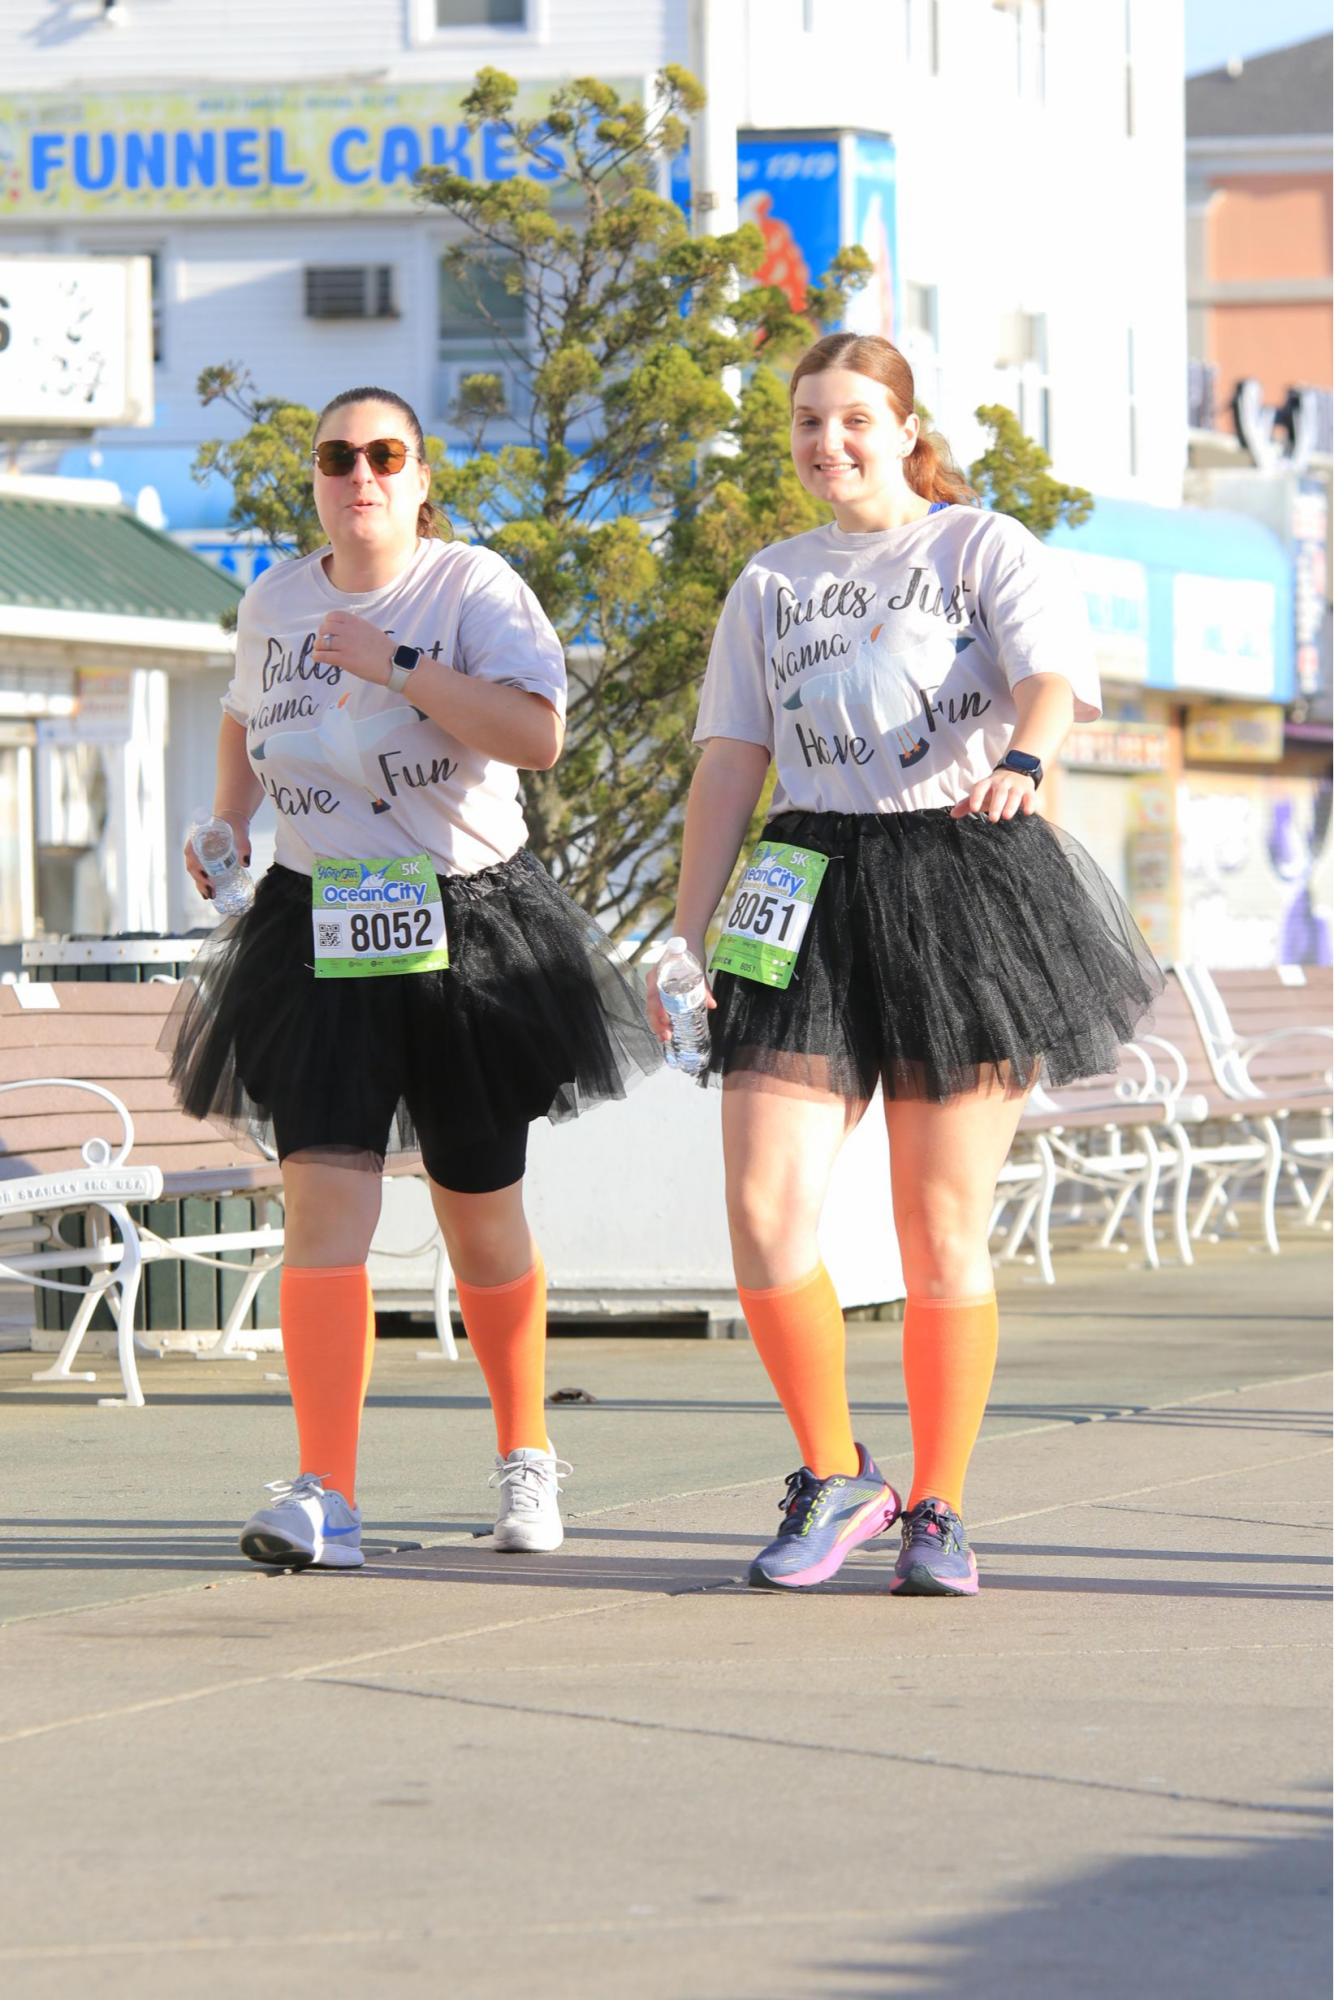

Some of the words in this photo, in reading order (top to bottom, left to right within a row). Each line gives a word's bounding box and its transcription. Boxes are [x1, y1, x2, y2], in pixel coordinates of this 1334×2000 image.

[31, 128, 304, 191] FUNNEL
[330, 124, 566, 184] CAKES
[776, 580, 877, 640] Gulls
[919, 685, 992, 733] Fun
[795, 723, 875, 768] Have
[378, 750, 458, 796] Fun
[401, 861, 420, 876] 5K
[790, 852, 810, 868] 5K
[350, 909, 433, 952] 8052
[728, 892, 795, 941] 8051
[116, 1179, 144, 1190] USA
